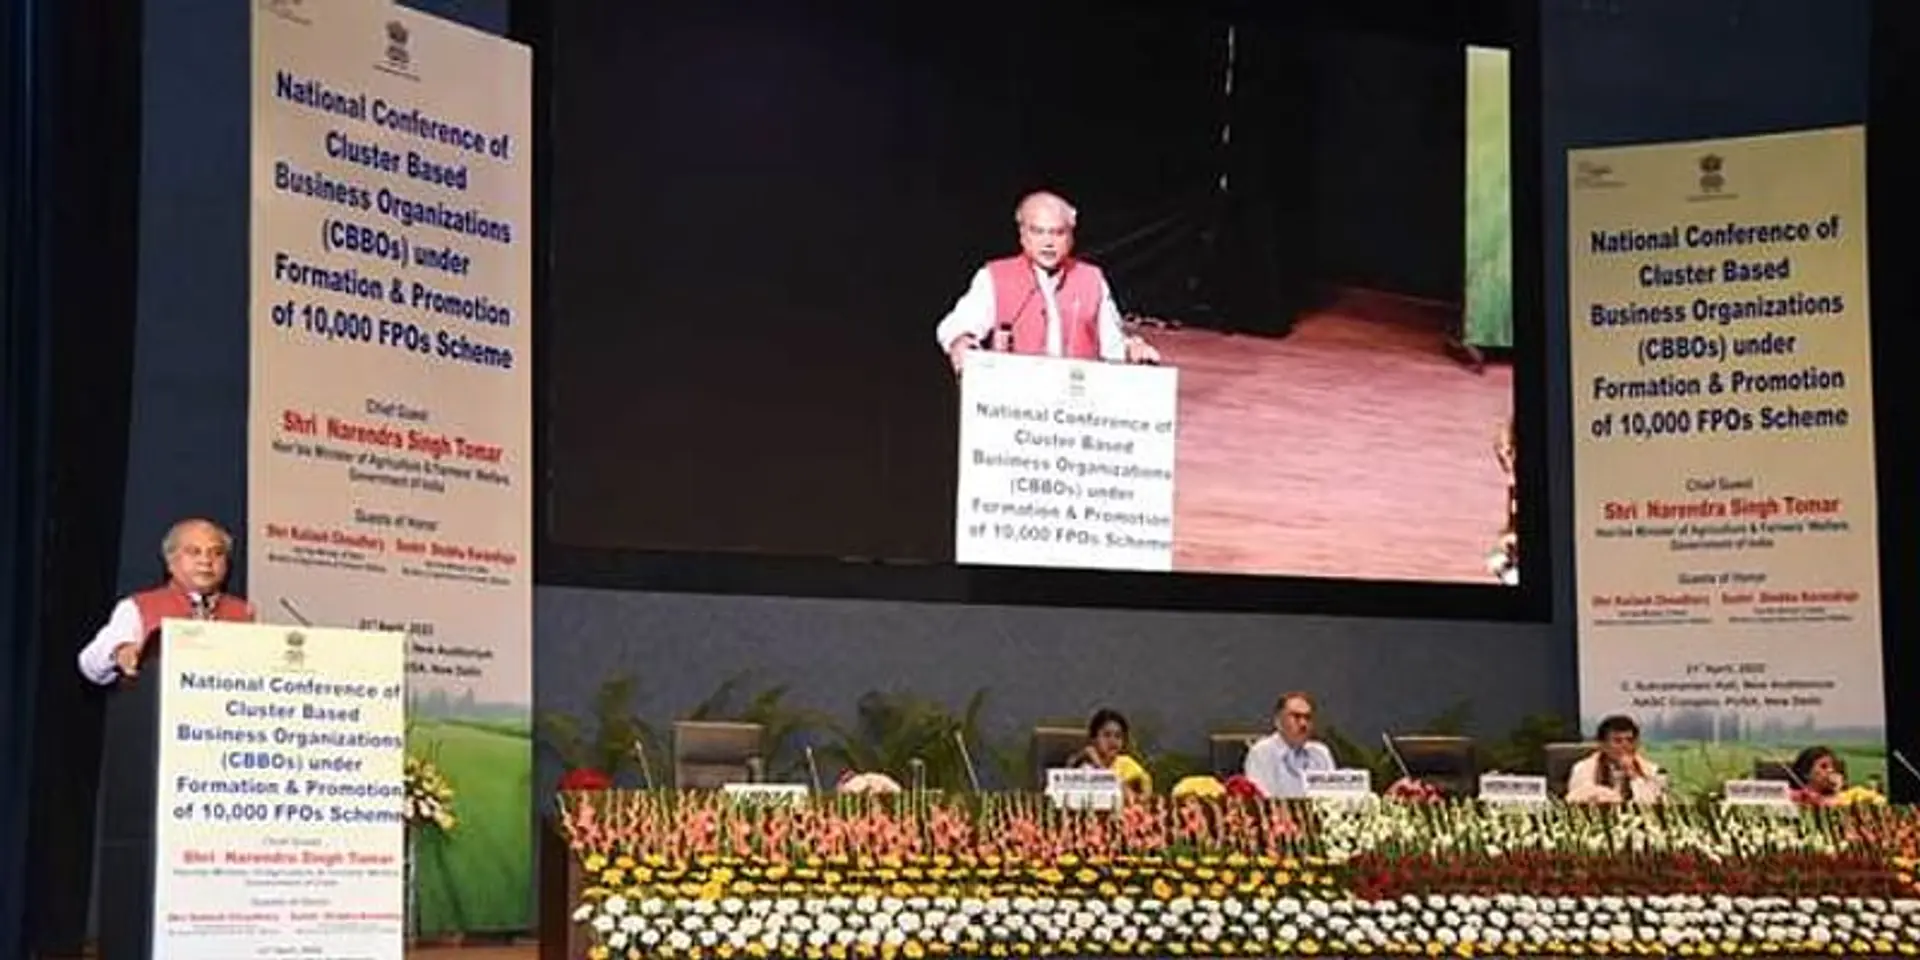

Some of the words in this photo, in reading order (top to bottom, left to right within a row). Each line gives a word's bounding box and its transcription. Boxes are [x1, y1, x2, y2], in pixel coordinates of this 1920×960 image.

[276, 70, 366, 120] National
[372, 100, 486, 154] Conference
[490, 134, 509, 160] of
[326, 131, 400, 172] Cluster
[407, 152, 468, 190] Based
[275, 162, 371, 210] Business
[377, 188, 511, 243] Organizations
[323, 218, 409, 268] (CBBOs)
[414, 244, 470, 275] under
[1590, 226, 1679, 254] National
[1686, 219, 1810, 248] Conference
[1816, 214, 1840, 240] of
[1639, 264, 1716, 288] Cluster
[1722, 258, 1790, 283] Based
[275, 253, 383, 300] Formation
[389, 278, 405, 304] &
[412, 282, 511, 326] Promotion
[1590, 303, 1686, 327] Business
[1692, 293, 1845, 325] Organizations
[272, 301, 296, 328] of
[302, 305, 372, 341] 10,000
[379, 322, 431, 354] FPOs
[435, 331, 513, 369] Scheme
[1638, 334, 1727, 365] (CBBOs)
[1732, 333, 1797, 357] under
[1593, 374, 1700, 400] Formation
[1708, 372, 1723, 395] &
[1731, 366, 1845, 393] Promotion
[976, 402, 1049, 422] National
[1053, 409, 1150, 432] Conference
[1155, 420, 1172, 433] of
[1591, 413, 1612, 437] of
[1621, 410, 1691, 440] 10,000
[1699, 408, 1753, 432] FPOs
[1760, 405, 1849, 430] Scheme
[283, 410, 316, 435] Shri
[326, 416, 403, 448] Narendra
[408, 429, 453, 460] Singh
[455, 436, 504, 462] Tomar
[1014, 429, 1076, 448] Cluster
[1081, 435, 1135, 454] Based
[973, 449, 1051, 470] Business
[1056, 457, 1172, 481] Organizations
[1010, 477, 1082, 498] (CBBOs)
[1087, 486, 1135, 501] under
[972, 498, 1060, 518] Formation
[1066, 505, 1077, 520] &
[1084, 506, 1171, 527] Promotion
[1605, 501, 1637, 520] Shri
[1647, 499, 1726, 519] Narendra
[1731, 496, 1778, 520] Singh
[1783, 496, 1840, 515] Tomar
[969, 523, 986, 538] of
[994, 523, 1052, 543] 10,000
[1056, 528, 1099, 545] FPOs
[180, 673, 265, 693] National
[269, 677, 378, 698] Conference
[382, 683, 401, 698] of
[225, 700, 296, 718] Cluster
[302, 703, 360, 722] Based
[177, 725, 267, 743] Business
[273, 727, 403, 749] Organizations
[221, 752, 303, 772] (CBBOs)
[309, 755, 362, 772] under
[176, 776, 280, 794] Formation
[286, 778, 299, 795] &
[306, 777, 404, 797] Promotion
[173, 803, 193, 820] of
[202, 803, 268, 823] 10,000
[274, 804, 323, 821] FPOs
